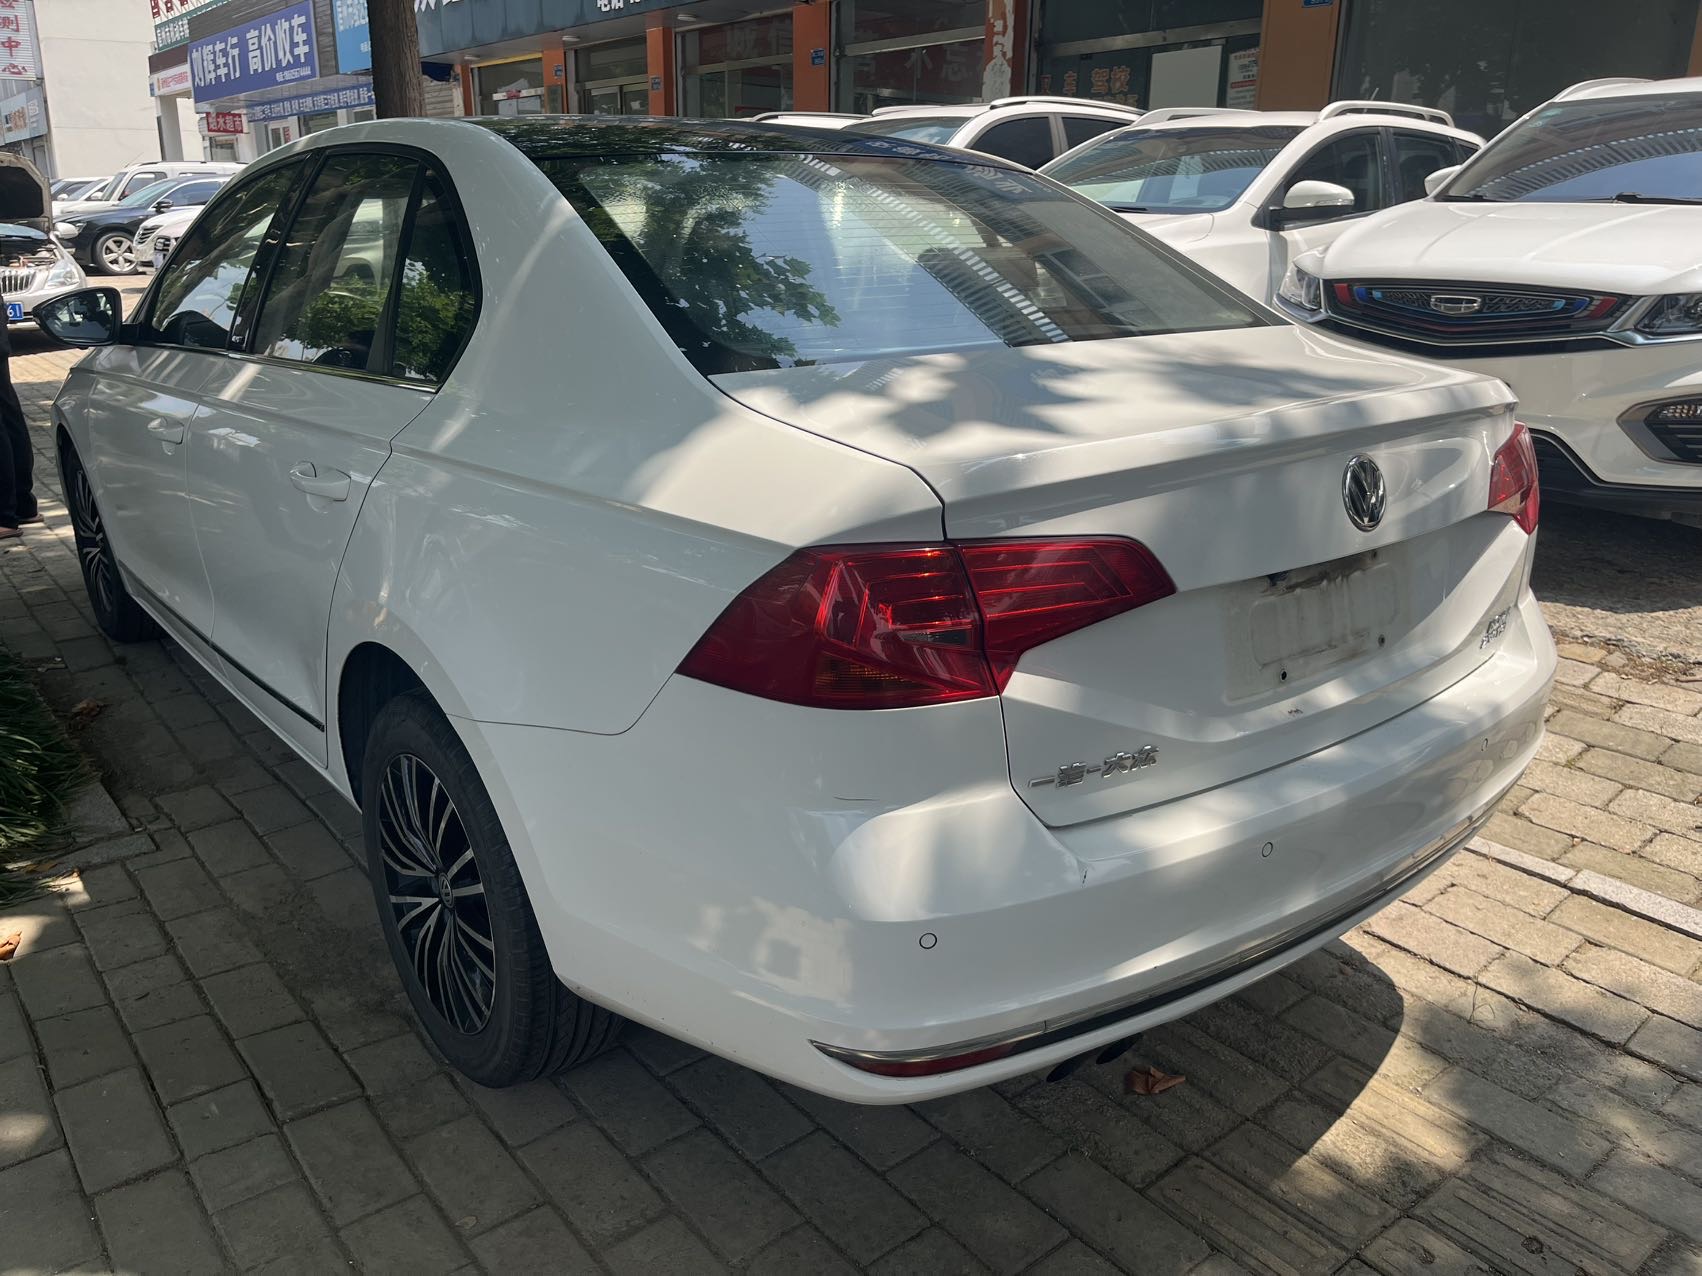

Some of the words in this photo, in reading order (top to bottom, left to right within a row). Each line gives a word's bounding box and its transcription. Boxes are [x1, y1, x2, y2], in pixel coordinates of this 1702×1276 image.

[192, 36, 240, 87] 刘辉车行
[246, 14, 309, 74] 高价收车
